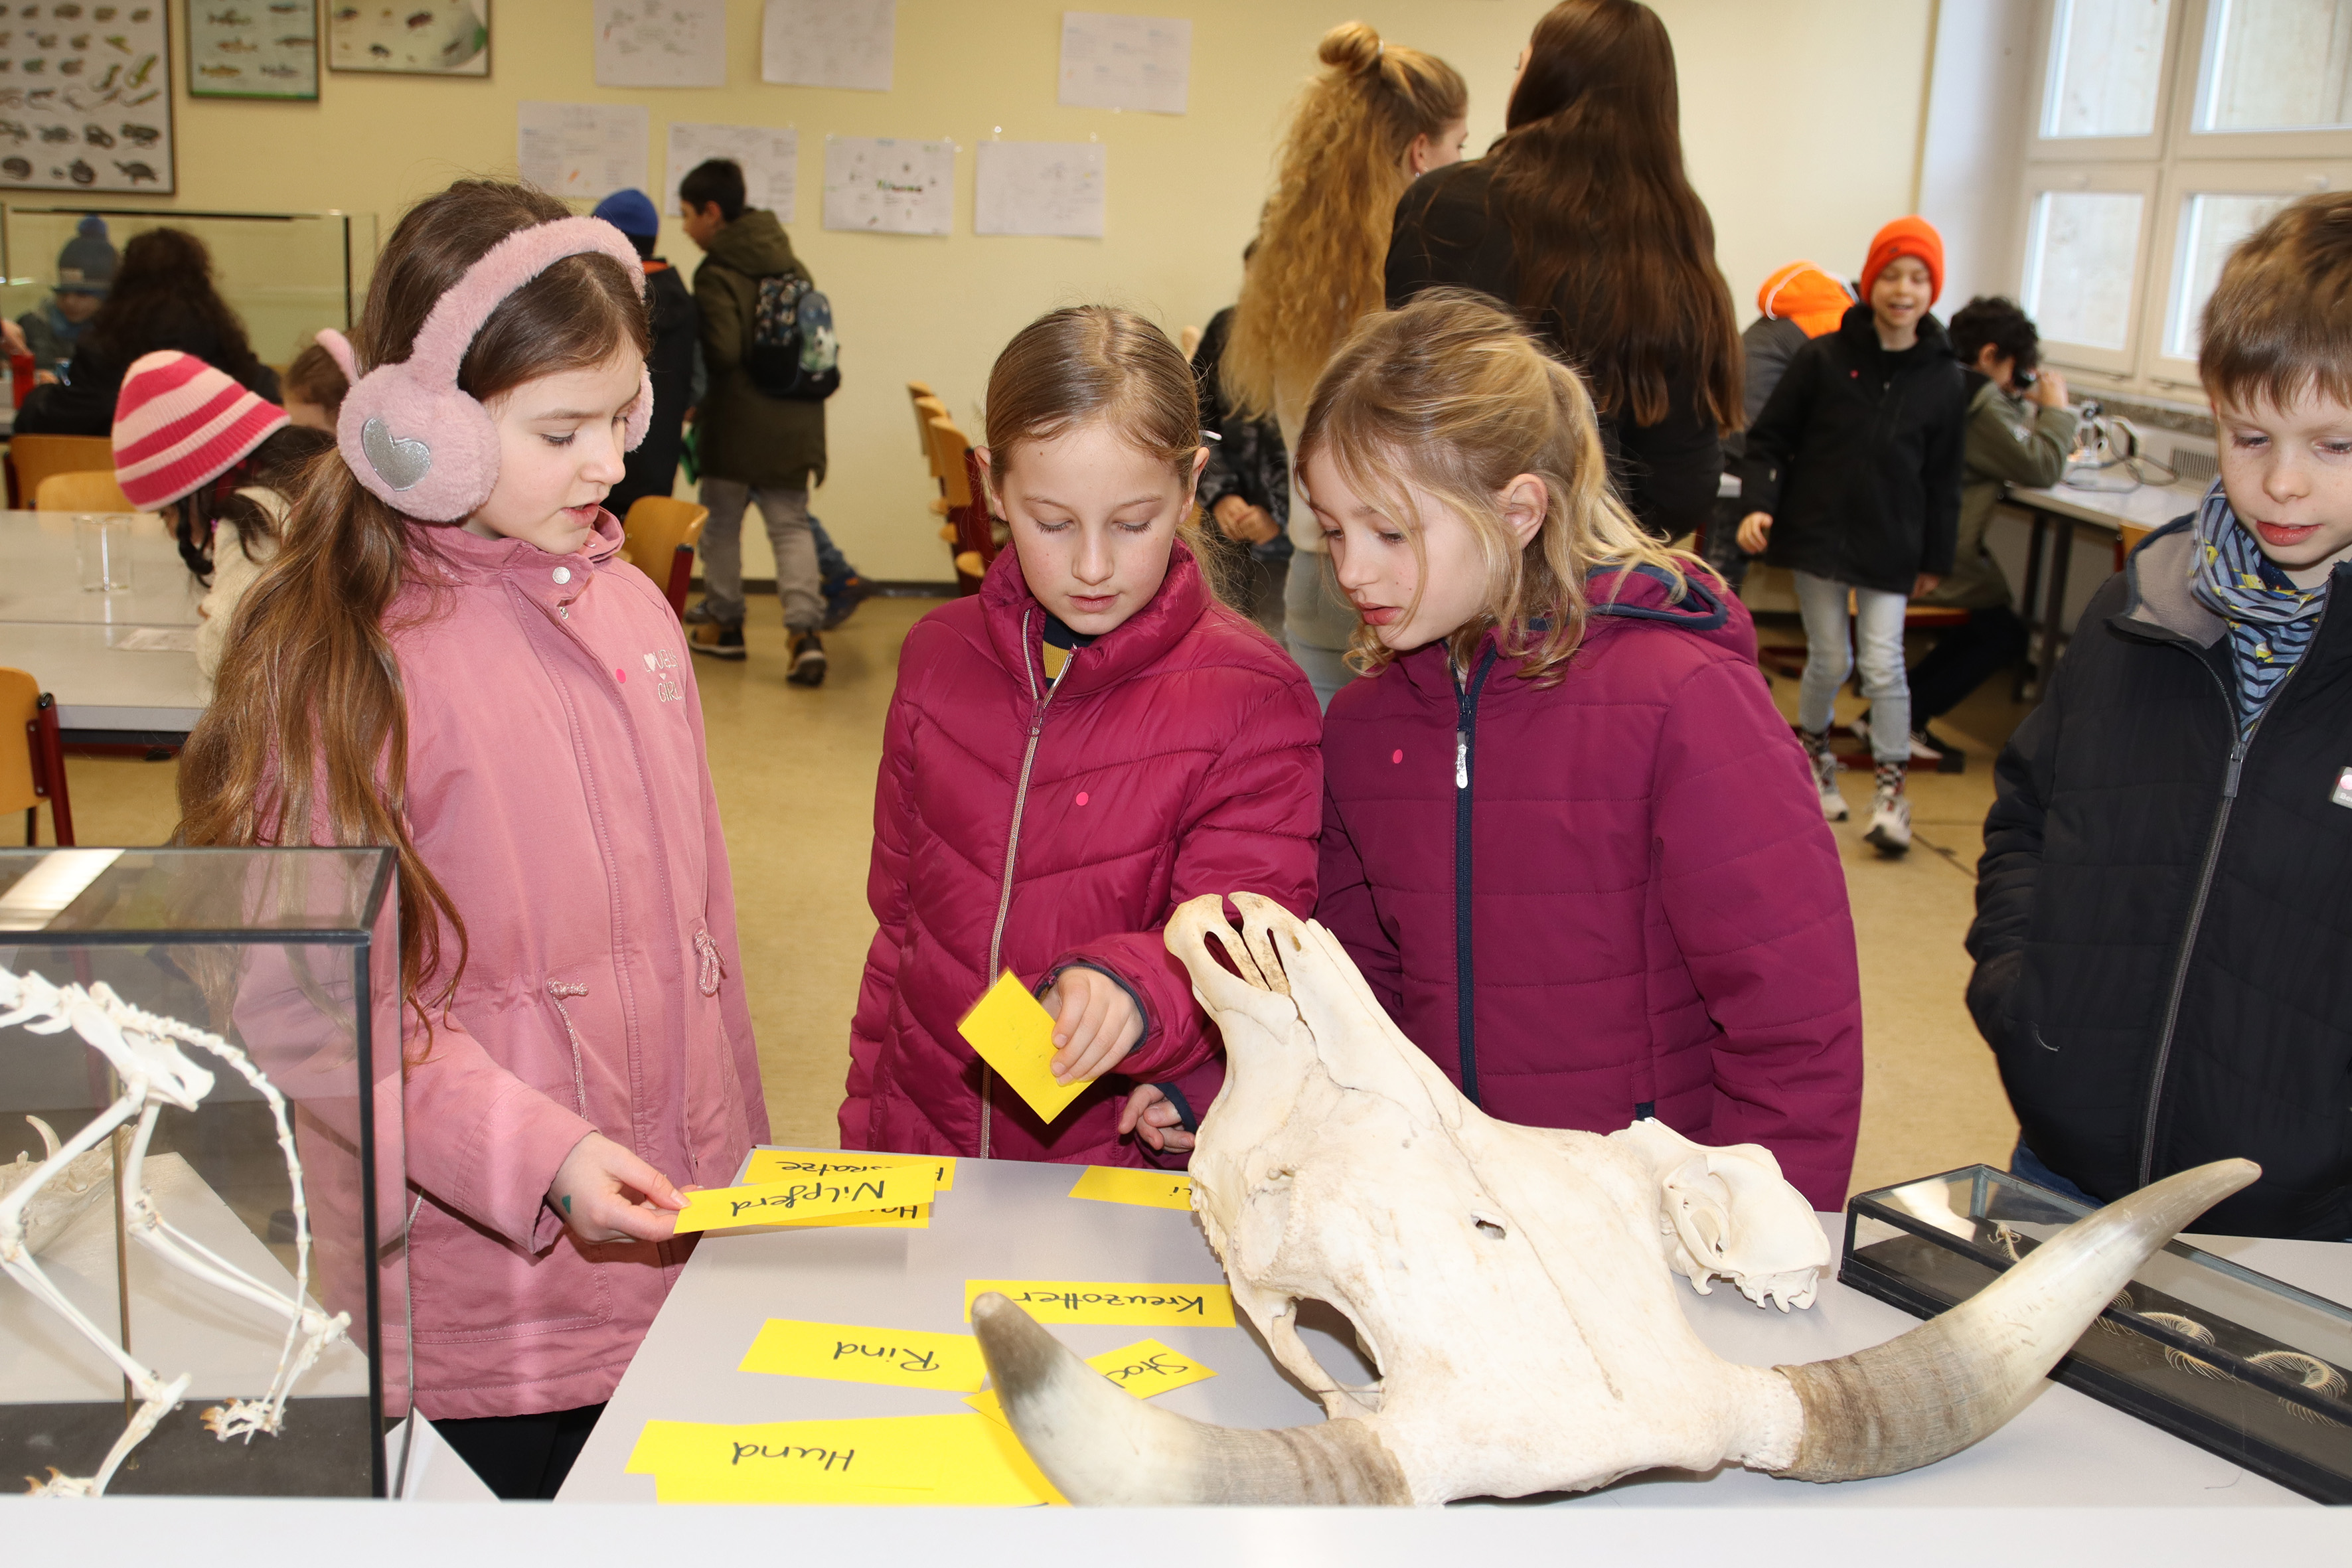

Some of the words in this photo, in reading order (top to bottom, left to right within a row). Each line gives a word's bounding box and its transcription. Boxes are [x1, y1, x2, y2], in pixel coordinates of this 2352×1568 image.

[658, 681, 682, 703] GIRL
[731, 1180, 885, 1217] Nilpferd
[1010, 1292, 1204, 1316] Kreuzotter
[833, 1342, 940, 1372] Rind
[732, 1443, 855, 1472] Hund
